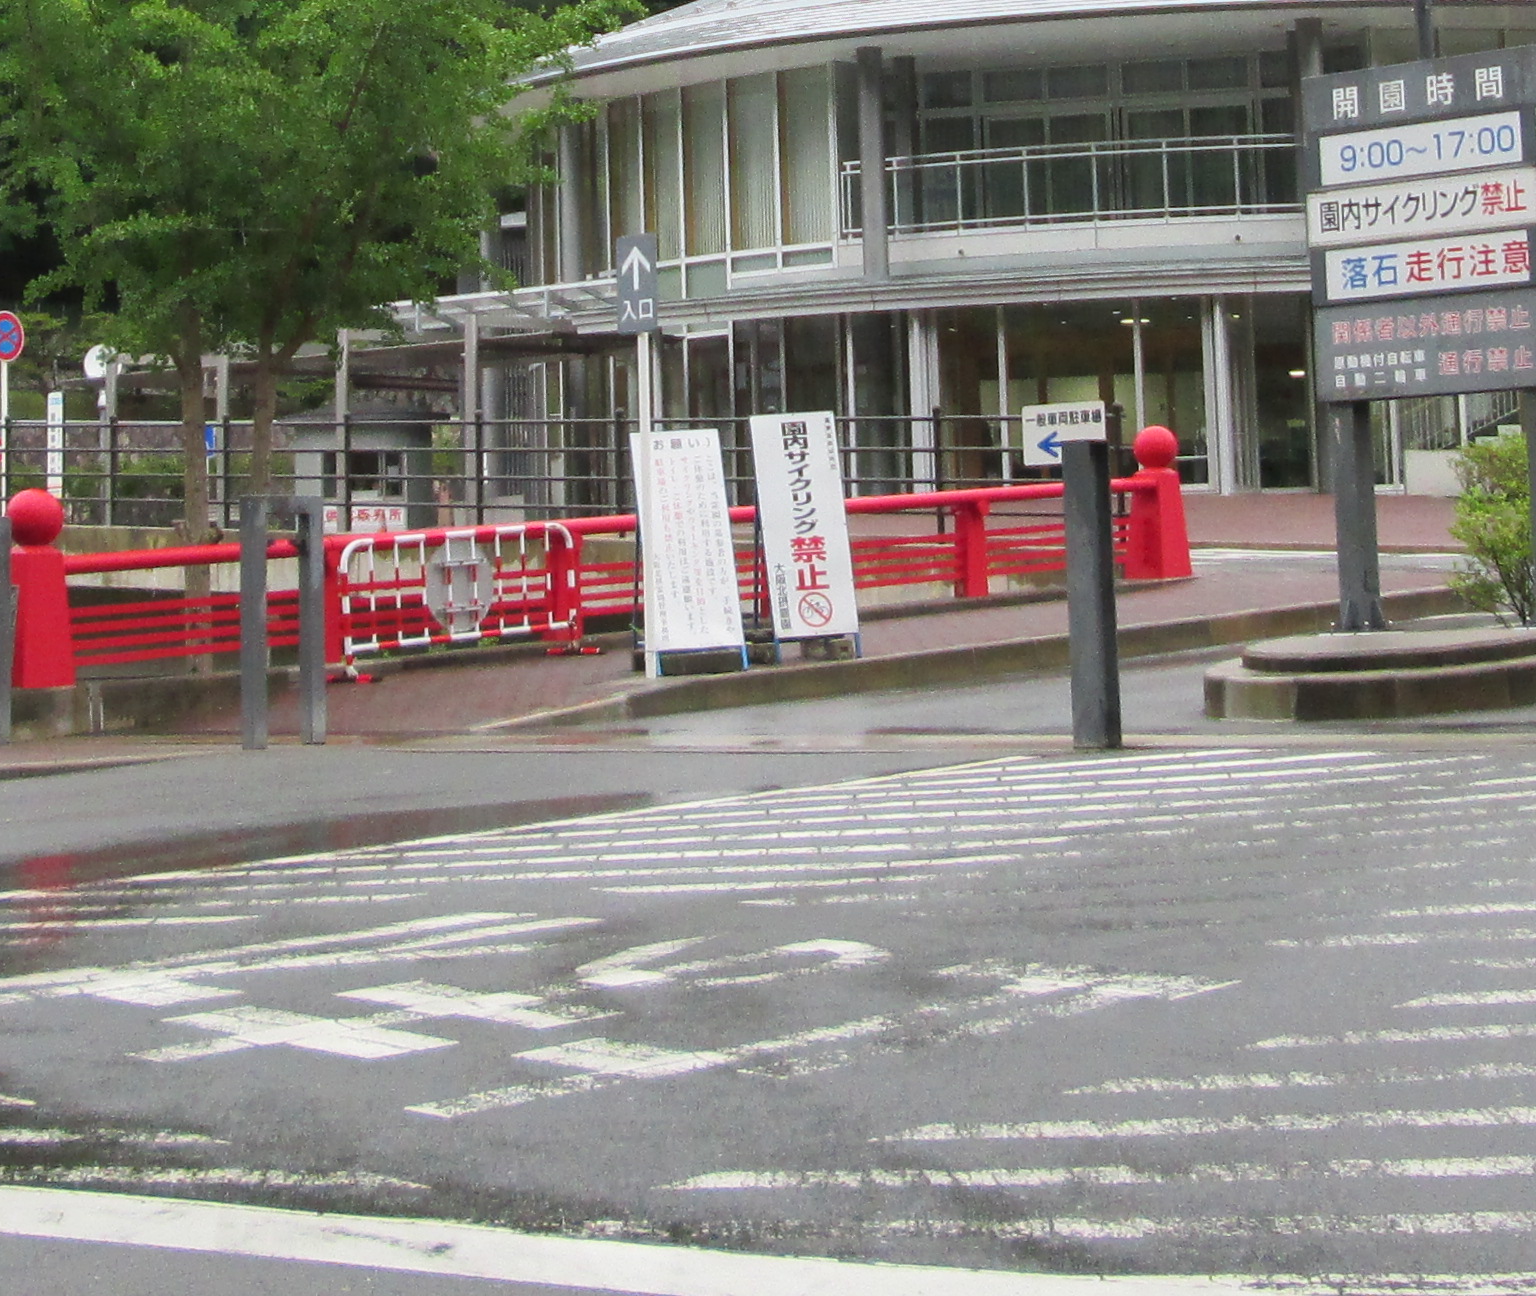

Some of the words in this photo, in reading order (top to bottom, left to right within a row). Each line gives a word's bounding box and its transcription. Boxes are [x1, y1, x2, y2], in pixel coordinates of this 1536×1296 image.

[1332, 65, 1504, 121] 開園時間
[1320, 179, 1527, 234] 園内サイクリング禁止
[1341, 239, 1532, 290] 落石走行注意
[621, 298, 654, 322] 入口
[1332, 305, 1531, 344] 関係者以外通行禁止
[1439, 345, 1534, 376] 通行禁止
[780, 421, 830, 591] 園内サイクリング禁止
